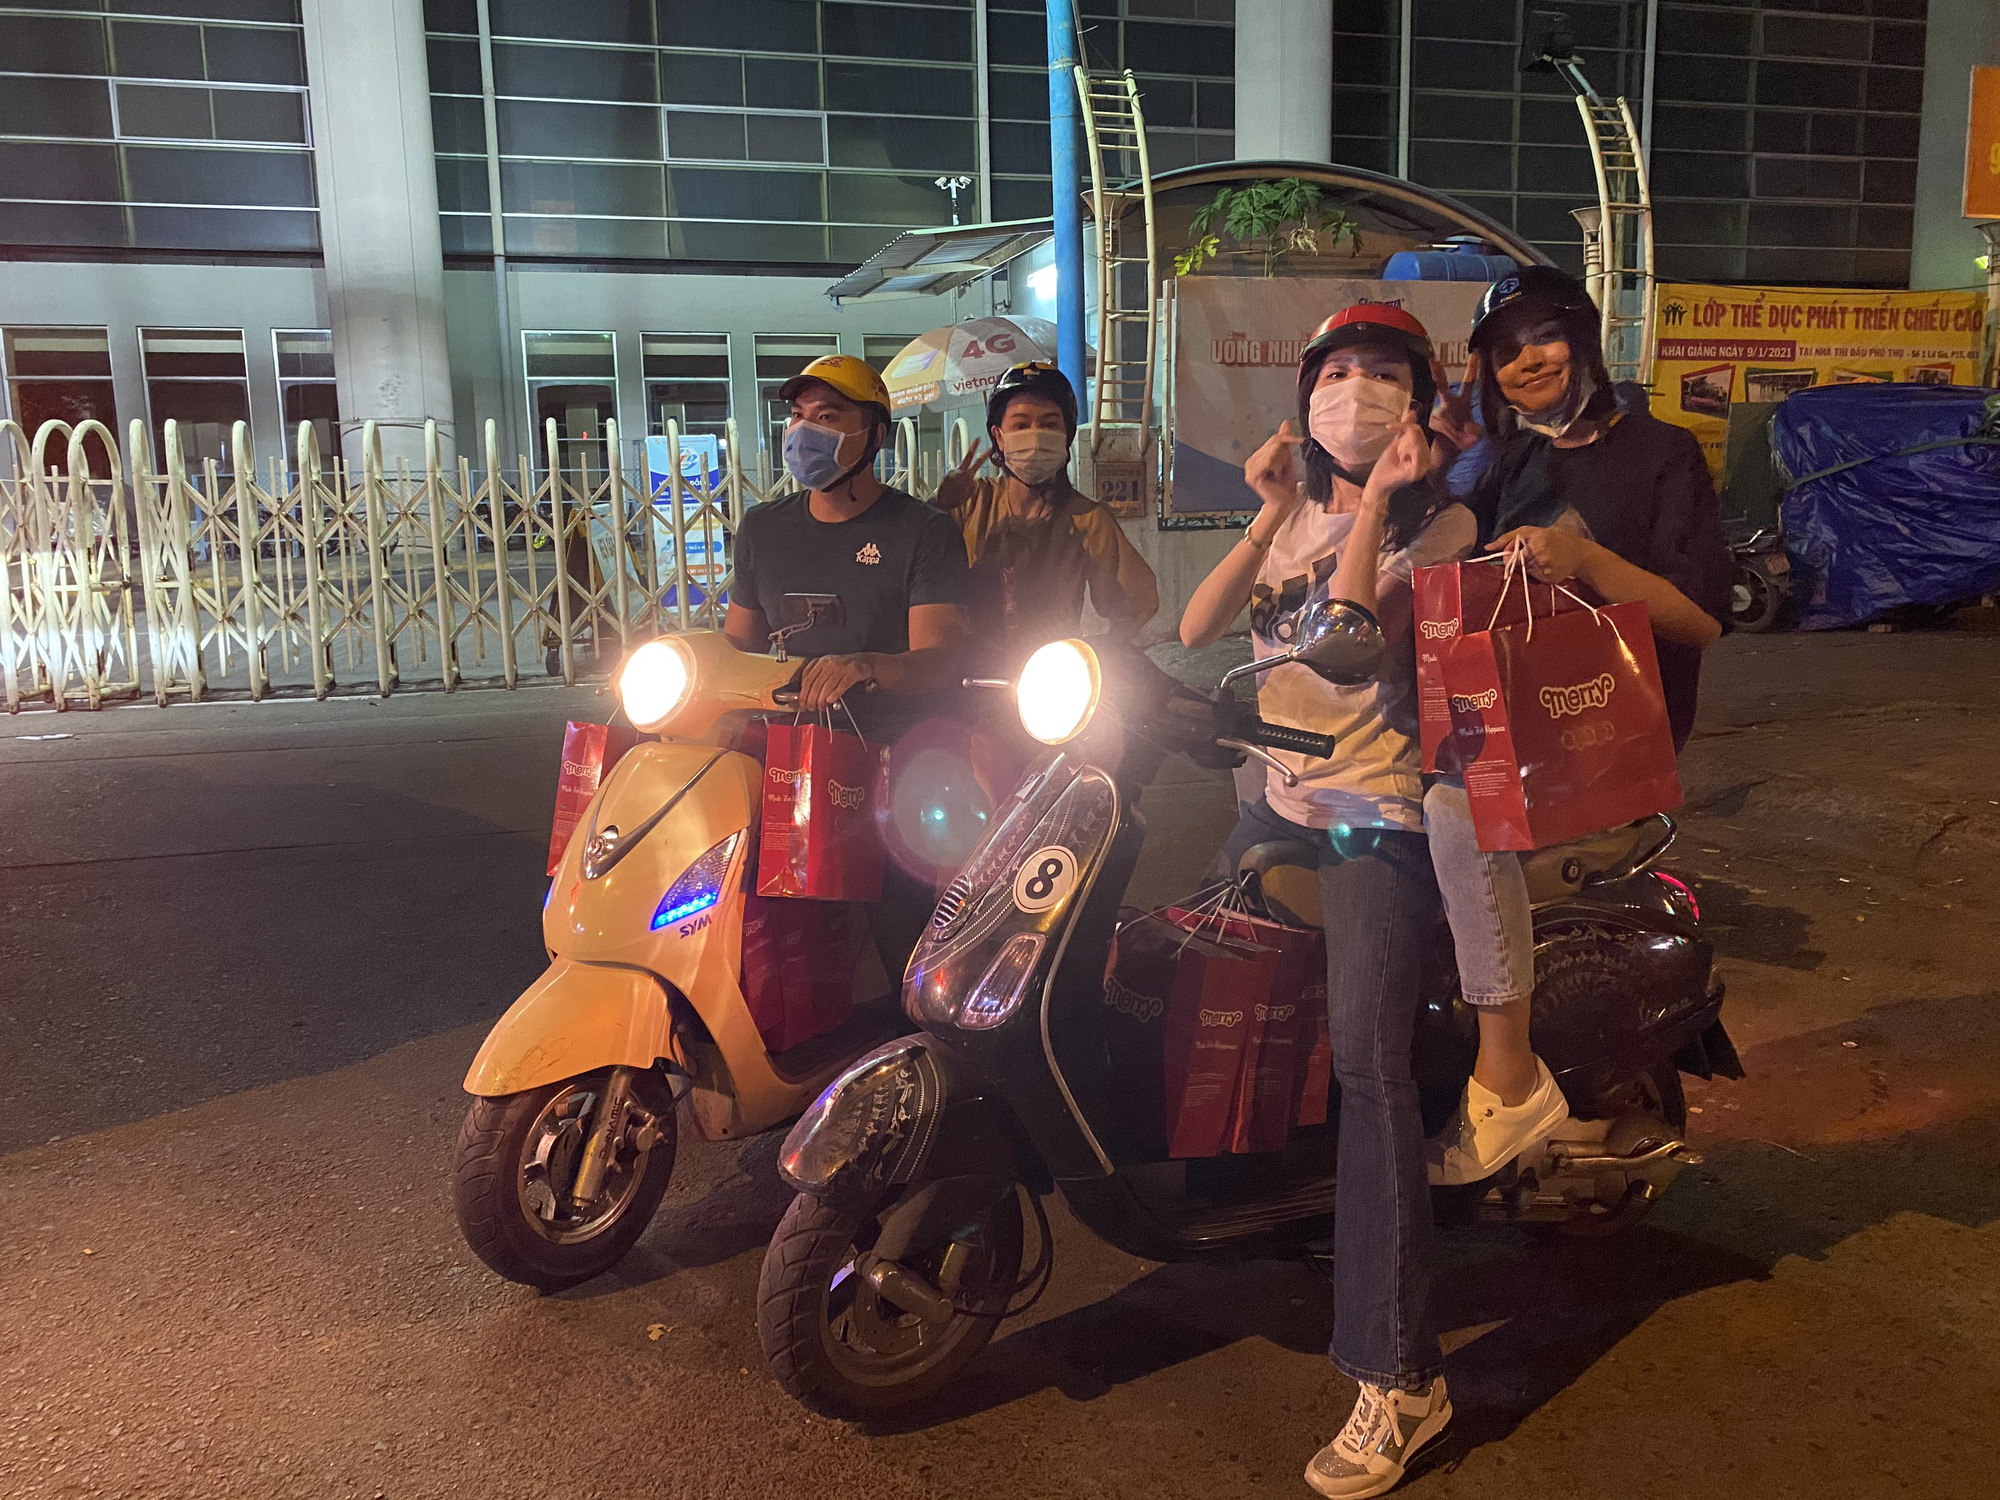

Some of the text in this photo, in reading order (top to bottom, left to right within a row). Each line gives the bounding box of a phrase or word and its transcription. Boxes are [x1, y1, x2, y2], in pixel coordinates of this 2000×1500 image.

[1693, 297, 1727, 328] LỚP
[1731, 292, 1765, 328] THỂ
[1768, 304, 1803, 333] DỤC
[1806, 300, 1848, 329] PHÁT
[1853, 295, 1900, 331] TRIỂN
[1953, 309, 1984, 332] CAO
[962, 334, 1016, 359] 4G
[1661, 341, 1791, 358] KHAI GIẢNG NGÀY 9/1/2021
[953, 374, 999, 391] vietna
[1102, 480, 1138, 501] 221
[856, 553, 880, 565] Kappa
[1025, 858, 1063, 900] 8
[679, 914, 712, 939] SYM
